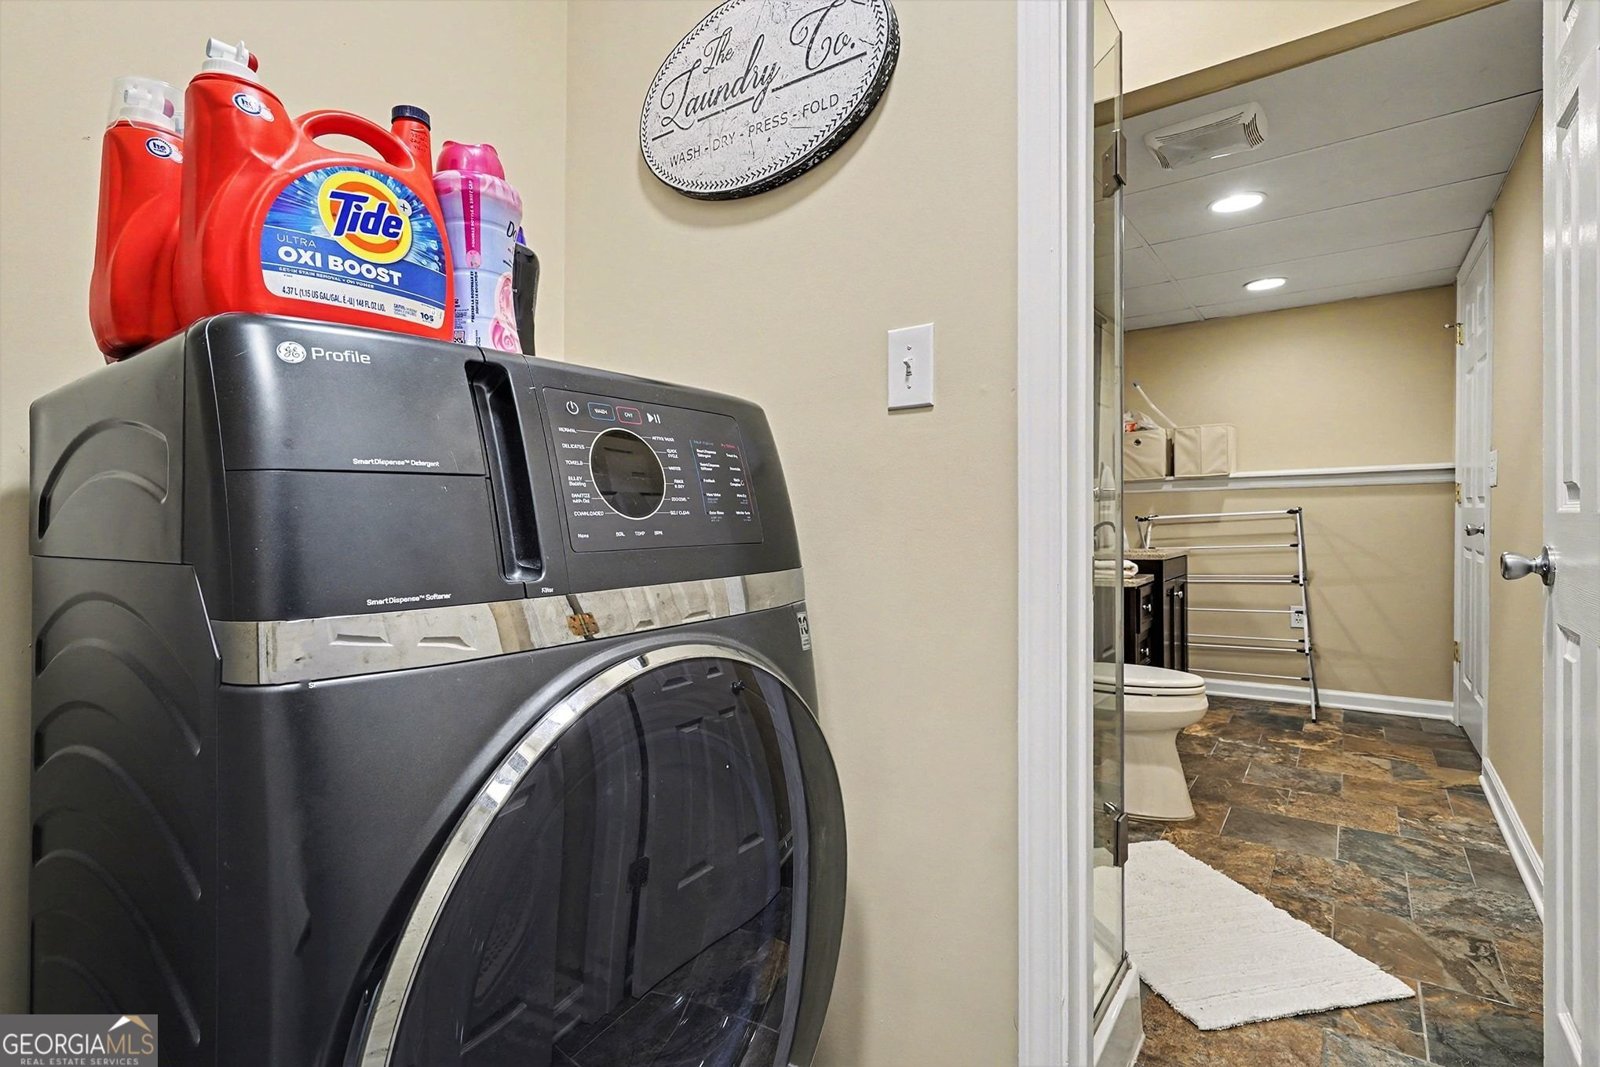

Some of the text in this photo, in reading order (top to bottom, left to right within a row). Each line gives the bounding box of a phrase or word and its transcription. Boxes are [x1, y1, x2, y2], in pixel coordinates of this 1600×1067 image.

[703, 26, 734, 74] The
[660, 0, 855, 130] Laundry Co.
[670, 94, 839, 167] WASH DRY PRESS FOLD
[329, 190, 403, 239] Tide
[276, 233, 317, 249] ULTRA
[278, 245, 402, 286] OXI BOOST
[420, 312, 434, 322] 105
[311, 347, 371, 364] Profile
[411, 459, 440, 468] Detergent
[425, 593, 452, 601] Softener
